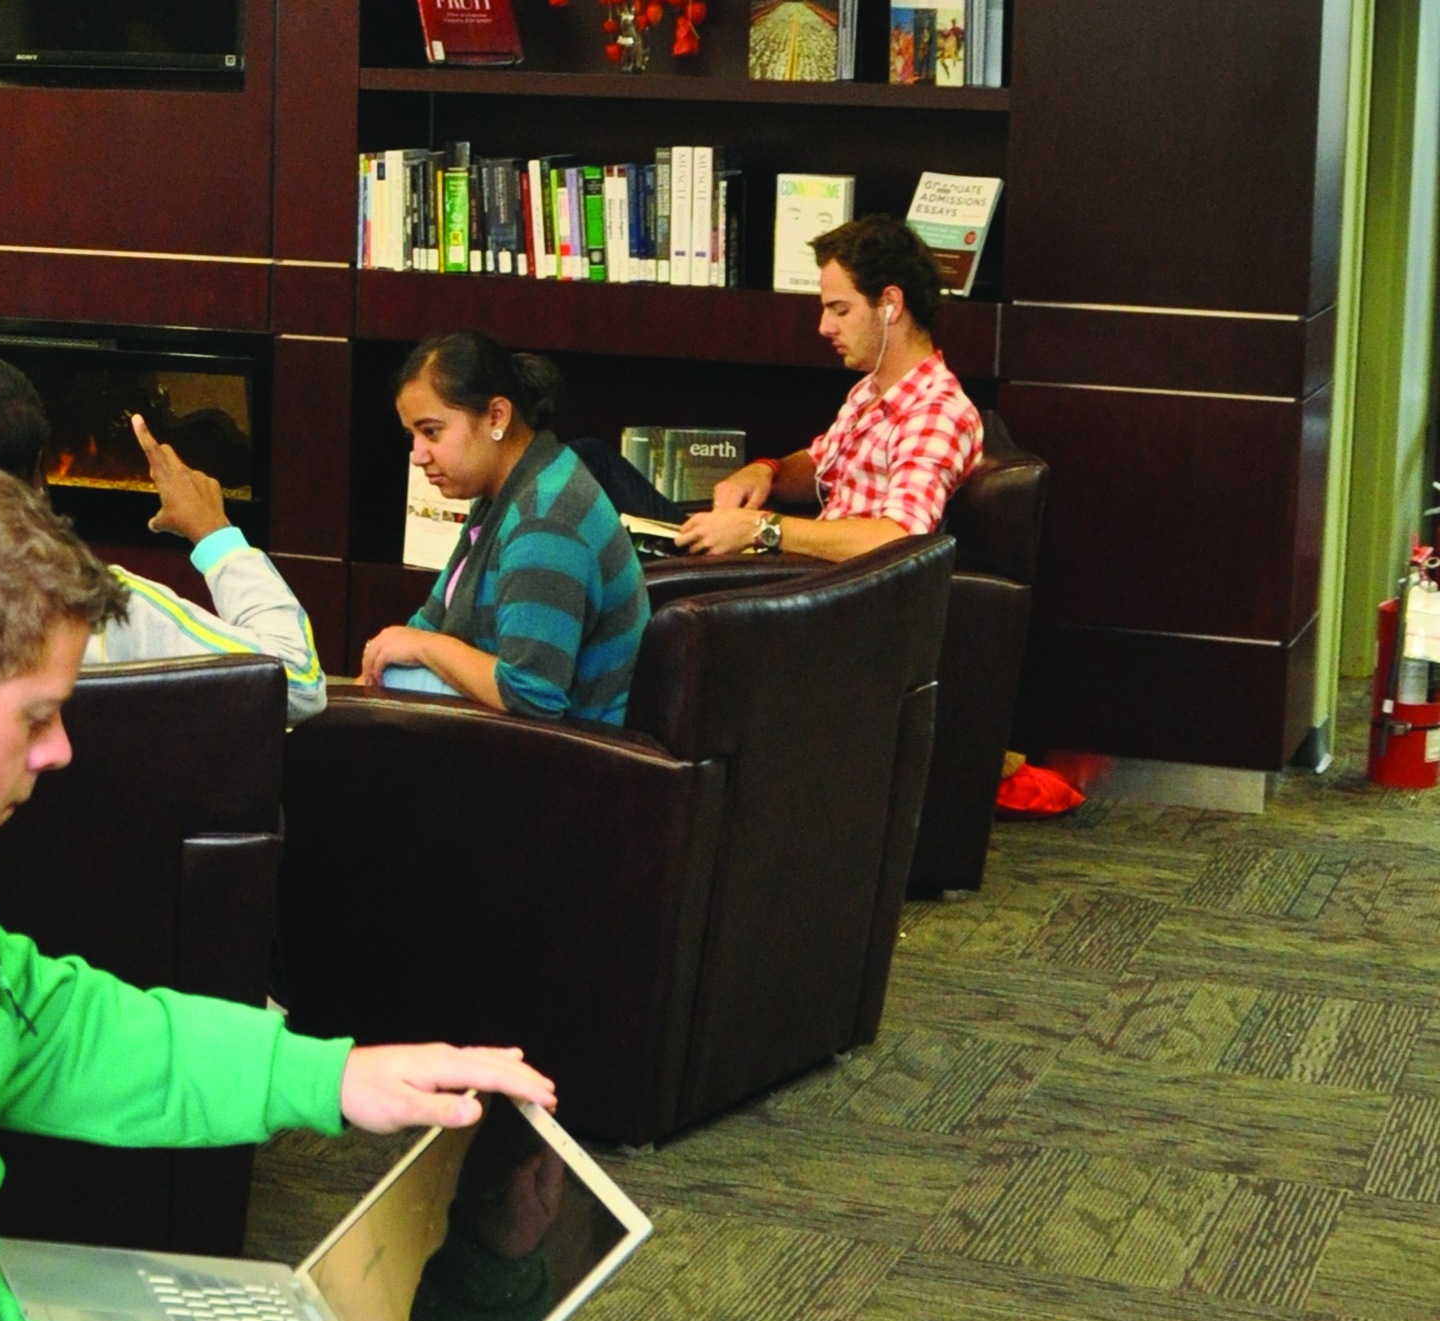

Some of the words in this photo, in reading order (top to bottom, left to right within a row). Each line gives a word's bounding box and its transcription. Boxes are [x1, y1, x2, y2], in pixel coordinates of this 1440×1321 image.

[919, 192, 987, 207] ADMISSIONS
[915, 203, 958, 218] ESSAYS
[690, 441, 736, 458] earth
